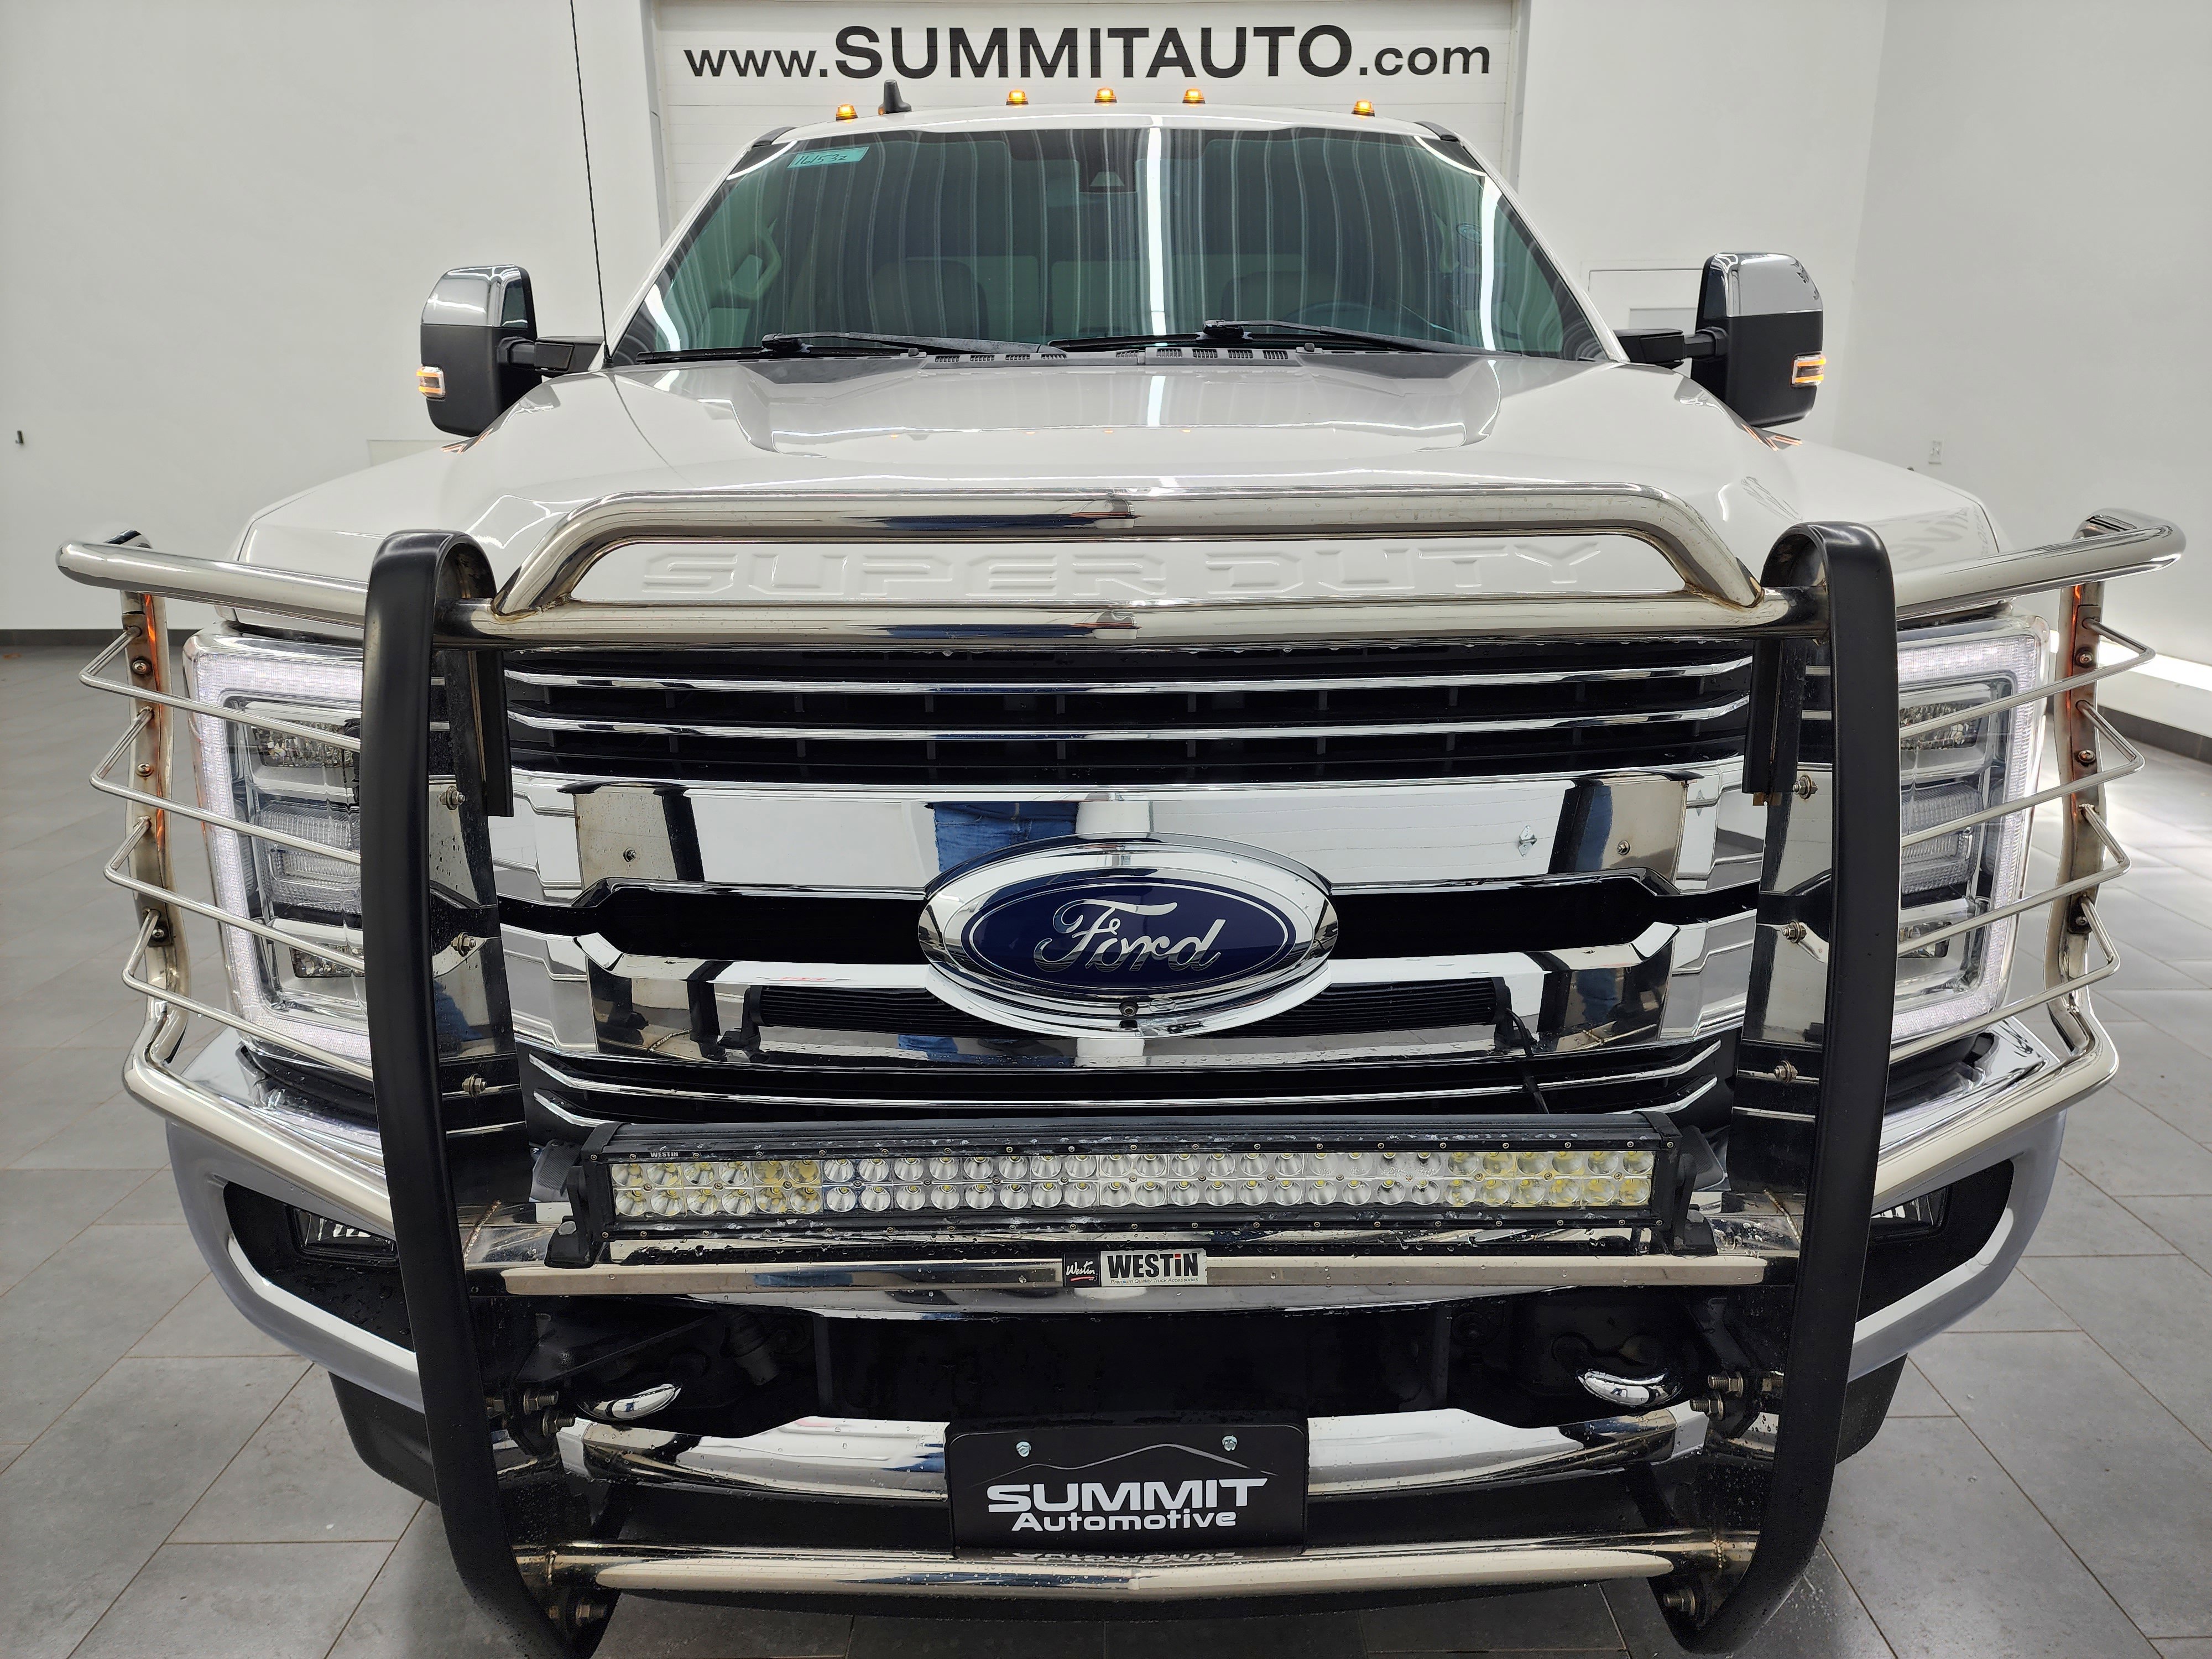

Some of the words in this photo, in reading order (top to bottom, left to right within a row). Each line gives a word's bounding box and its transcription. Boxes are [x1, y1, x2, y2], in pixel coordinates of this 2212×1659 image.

[683, 24, 1490, 79] www.SUMMITAUTO.com
[641, 552, 1166, 596] SUPER
[1206, 542, 1601, 594] DUTY
[1032, 898, 1227, 972] Ford
[1066, 1260, 1095, 1276] Westin
[987, 1478, 1268, 1513] SUMMIT
[1011, 1508, 1237, 1531] Automotive
